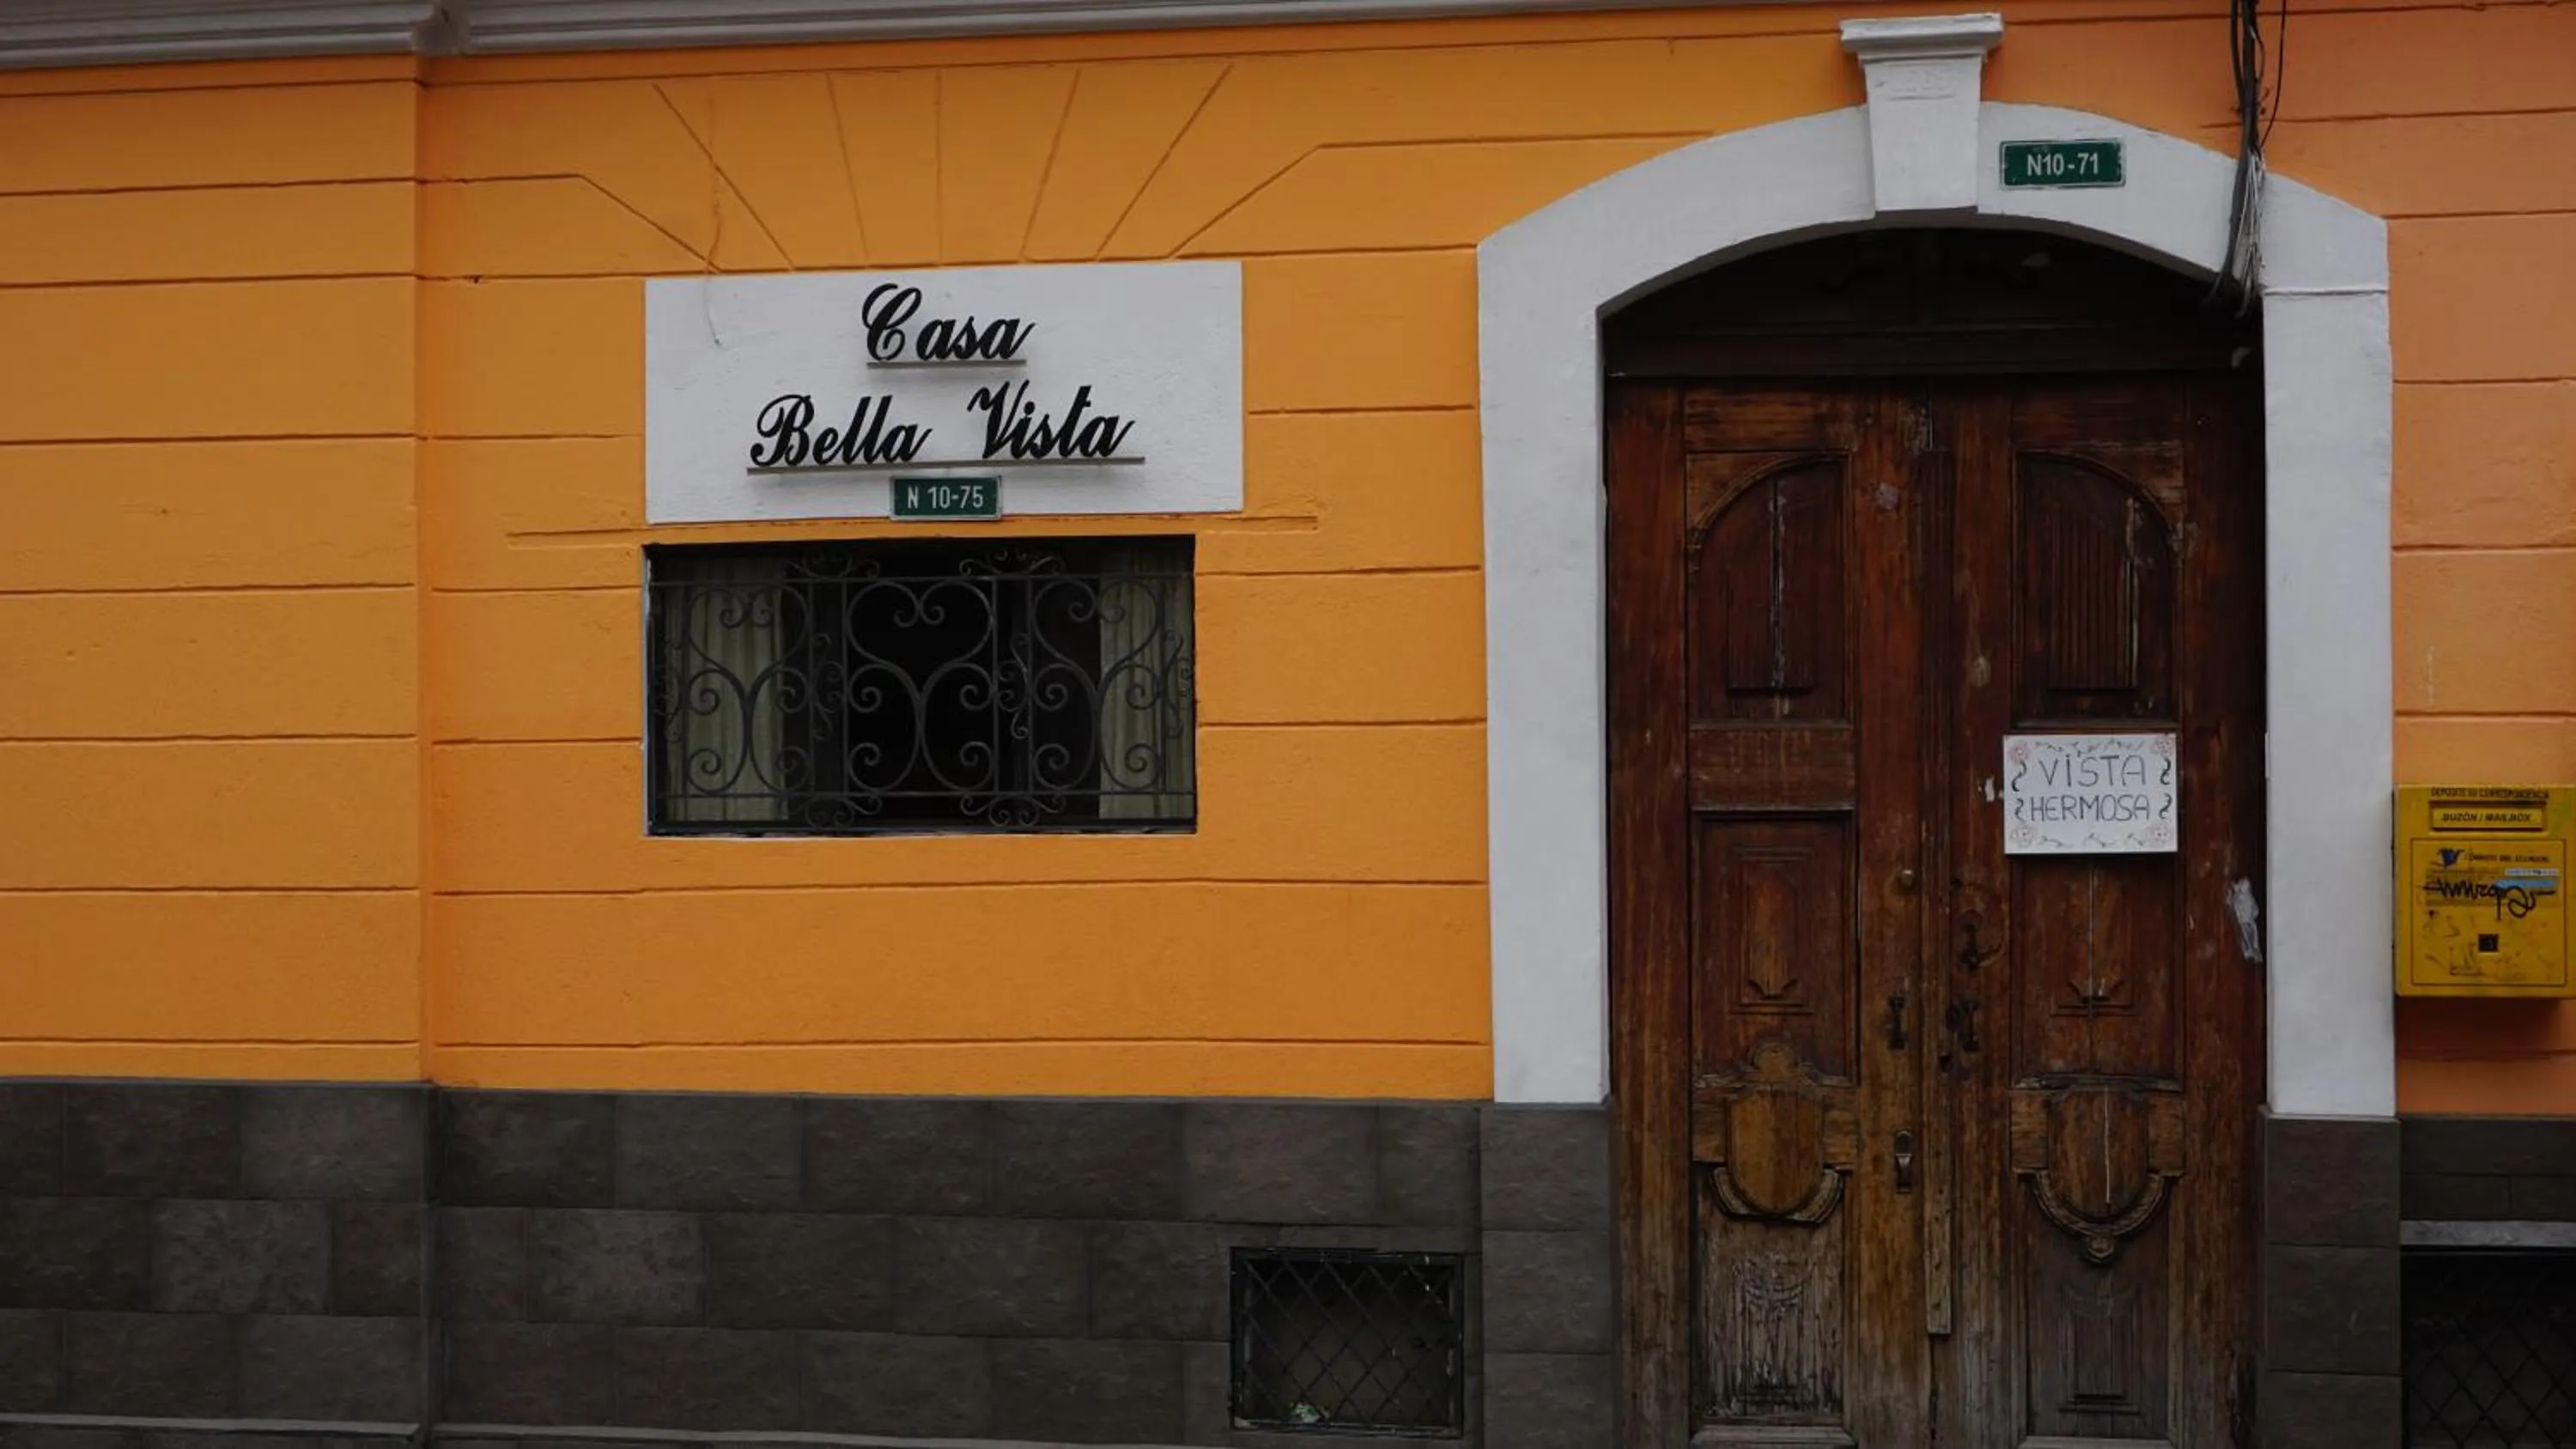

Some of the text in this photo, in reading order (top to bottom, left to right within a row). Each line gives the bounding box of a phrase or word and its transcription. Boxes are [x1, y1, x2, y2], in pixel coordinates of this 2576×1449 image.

[2027, 152, 2099, 176] N10-71
[861, 282, 1036, 361] Casa
[750, 379, 1136, 467] Bella Vista
[908, 485, 984, 509] N 10-75
[2030, 794, 2150, 822] HERMOSA
